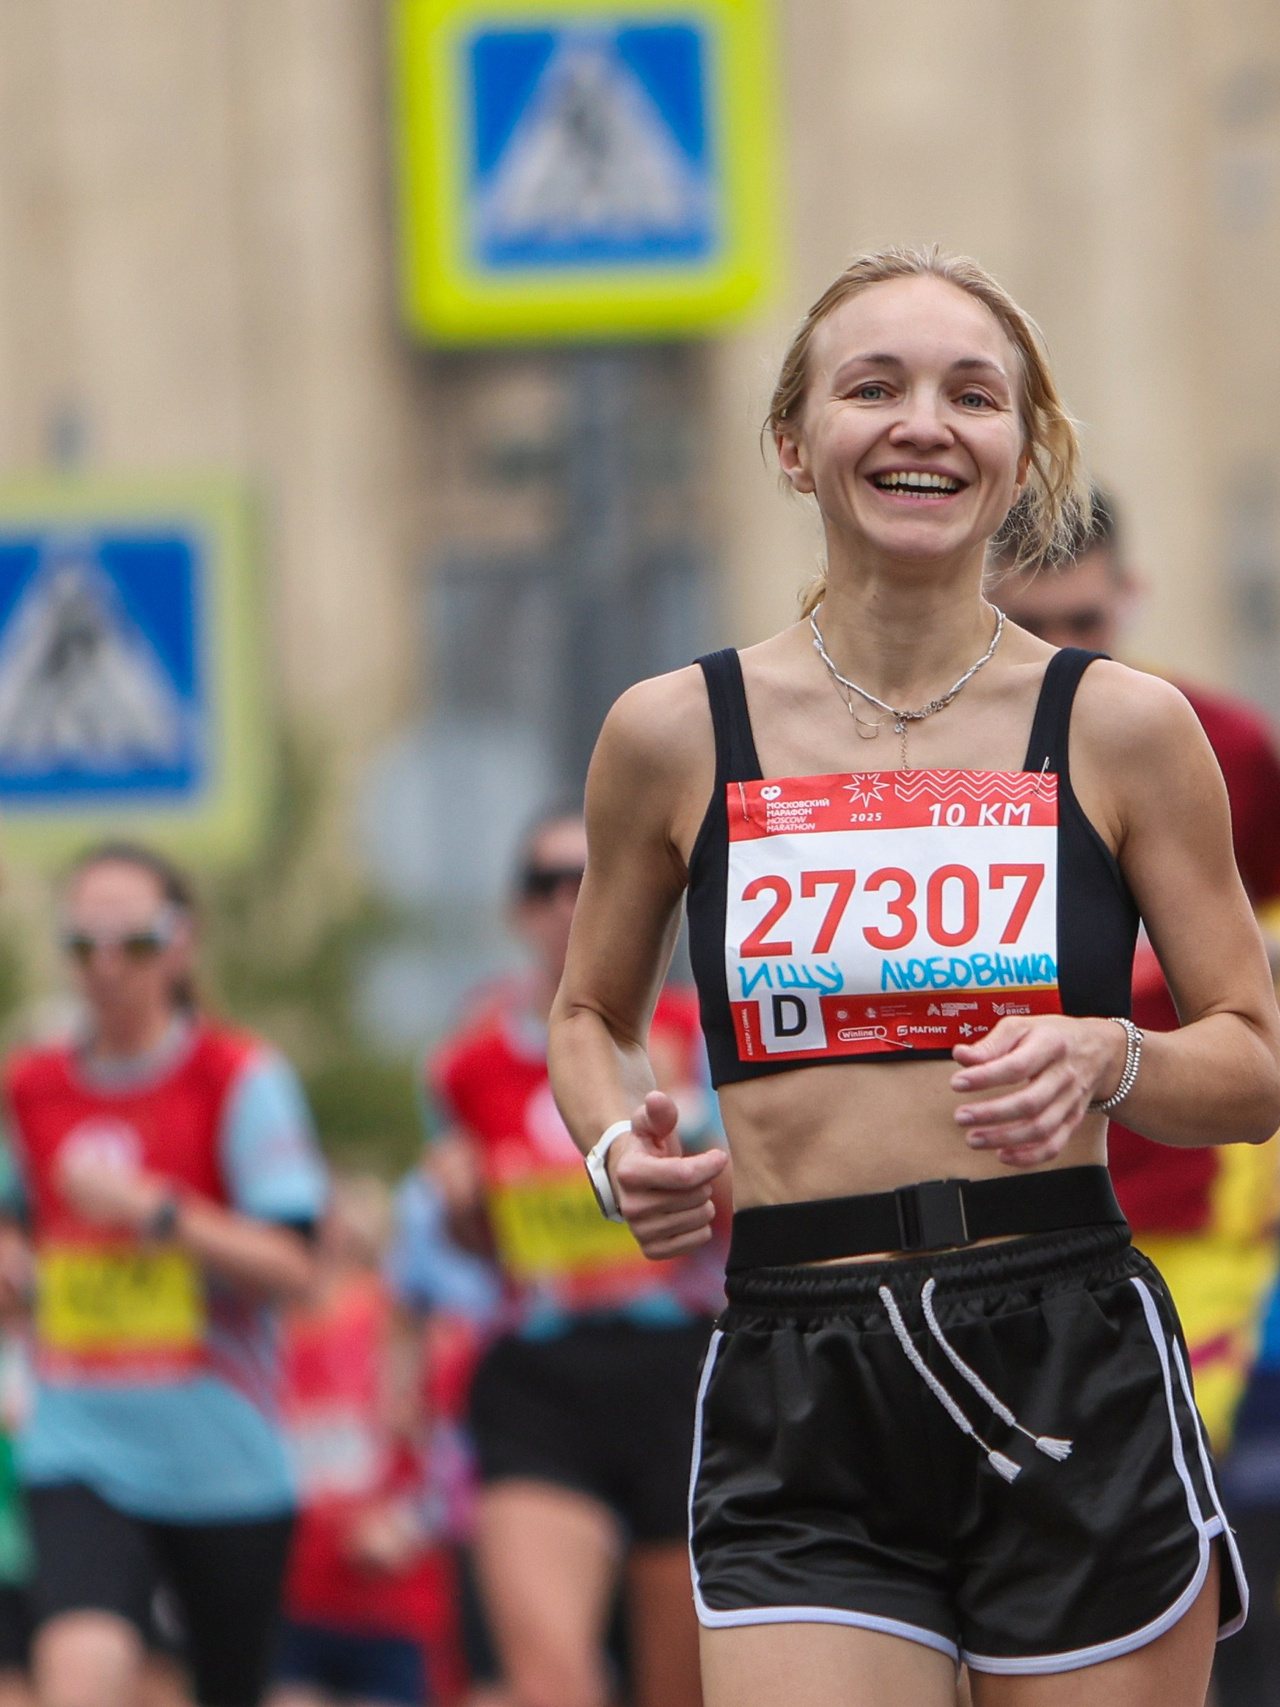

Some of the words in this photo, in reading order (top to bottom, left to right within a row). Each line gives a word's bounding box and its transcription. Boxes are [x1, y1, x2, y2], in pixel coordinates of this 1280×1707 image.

[766, 798, 830, 810] МОСКОВСКИЙ
[766, 808, 812, 818] МАРАФОН
[850, 812, 882, 822] 2025
[928, 803, 966, 827] 10
[978, 802, 1032, 826] KM
[766, 816, 807, 825] MOSCOW
[766, 823, 816, 833] MARATHON
[739, 863, 1045, 958] 27307
[739, 961, 845, 998] ИЩУ
[773, 995, 807, 1037] D
[842, 1029, 873, 1039] Winline
[909, 1026, 948, 1034] МАГНИТ
